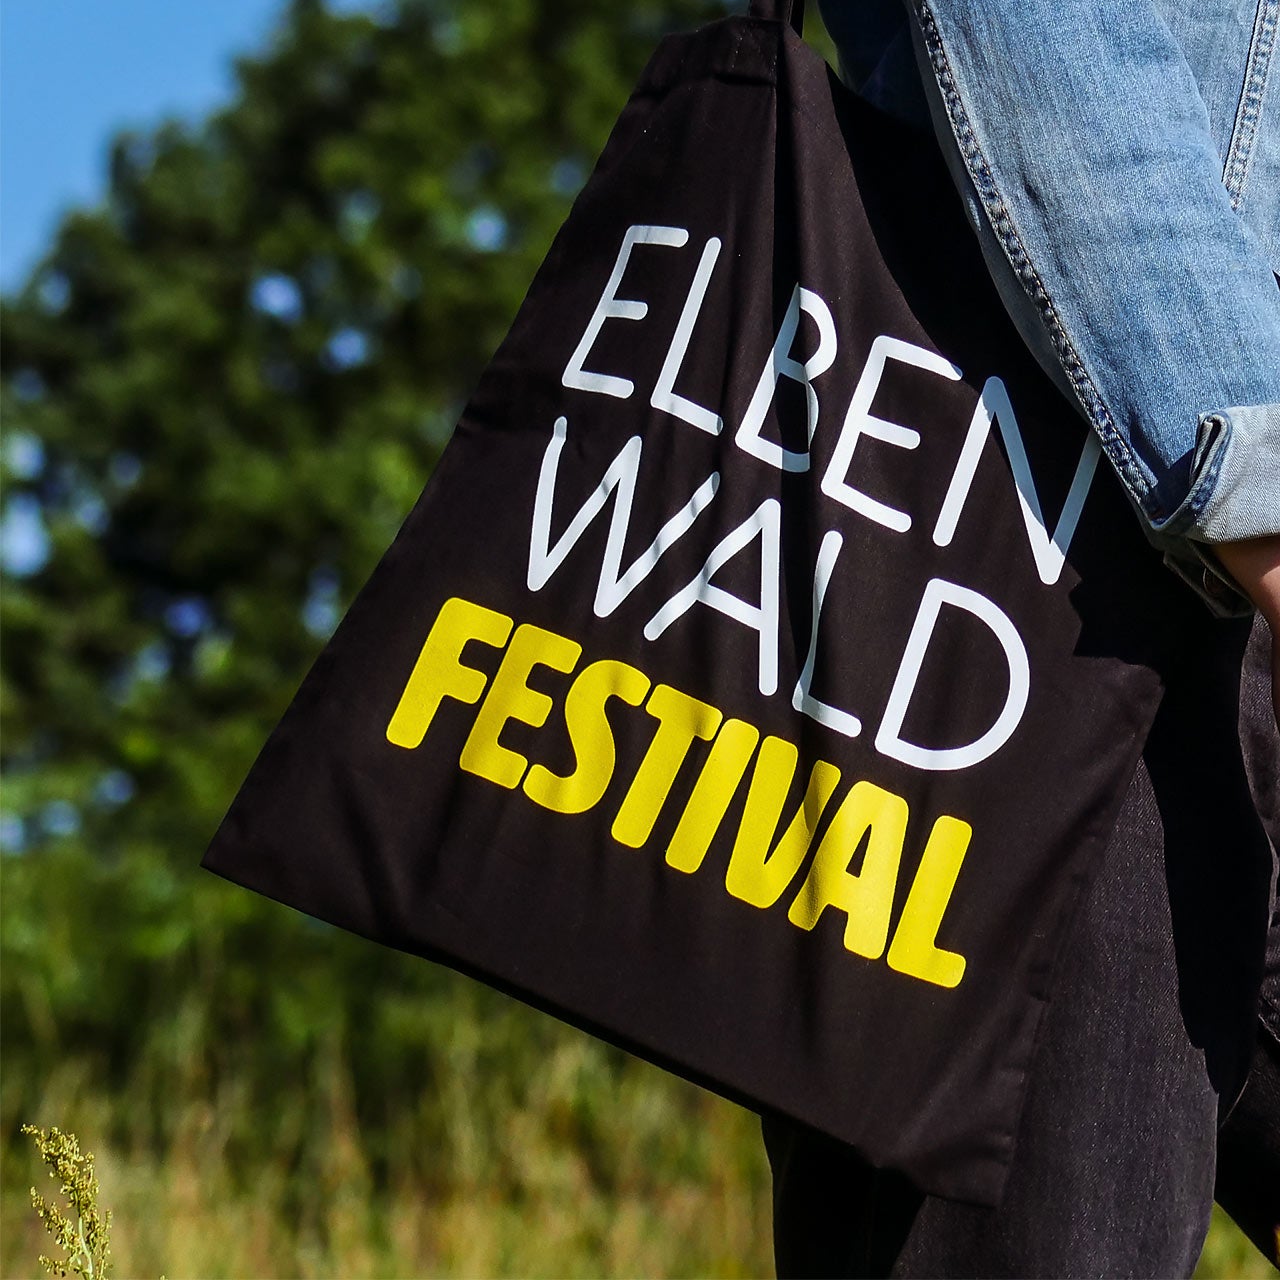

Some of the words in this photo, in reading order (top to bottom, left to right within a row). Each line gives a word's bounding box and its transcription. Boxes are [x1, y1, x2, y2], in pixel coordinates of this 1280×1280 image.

[561, 224, 1101, 585] ELBEN
[526, 415, 1031, 771] WALD
[385, 596, 973, 989] FESTIVAL
